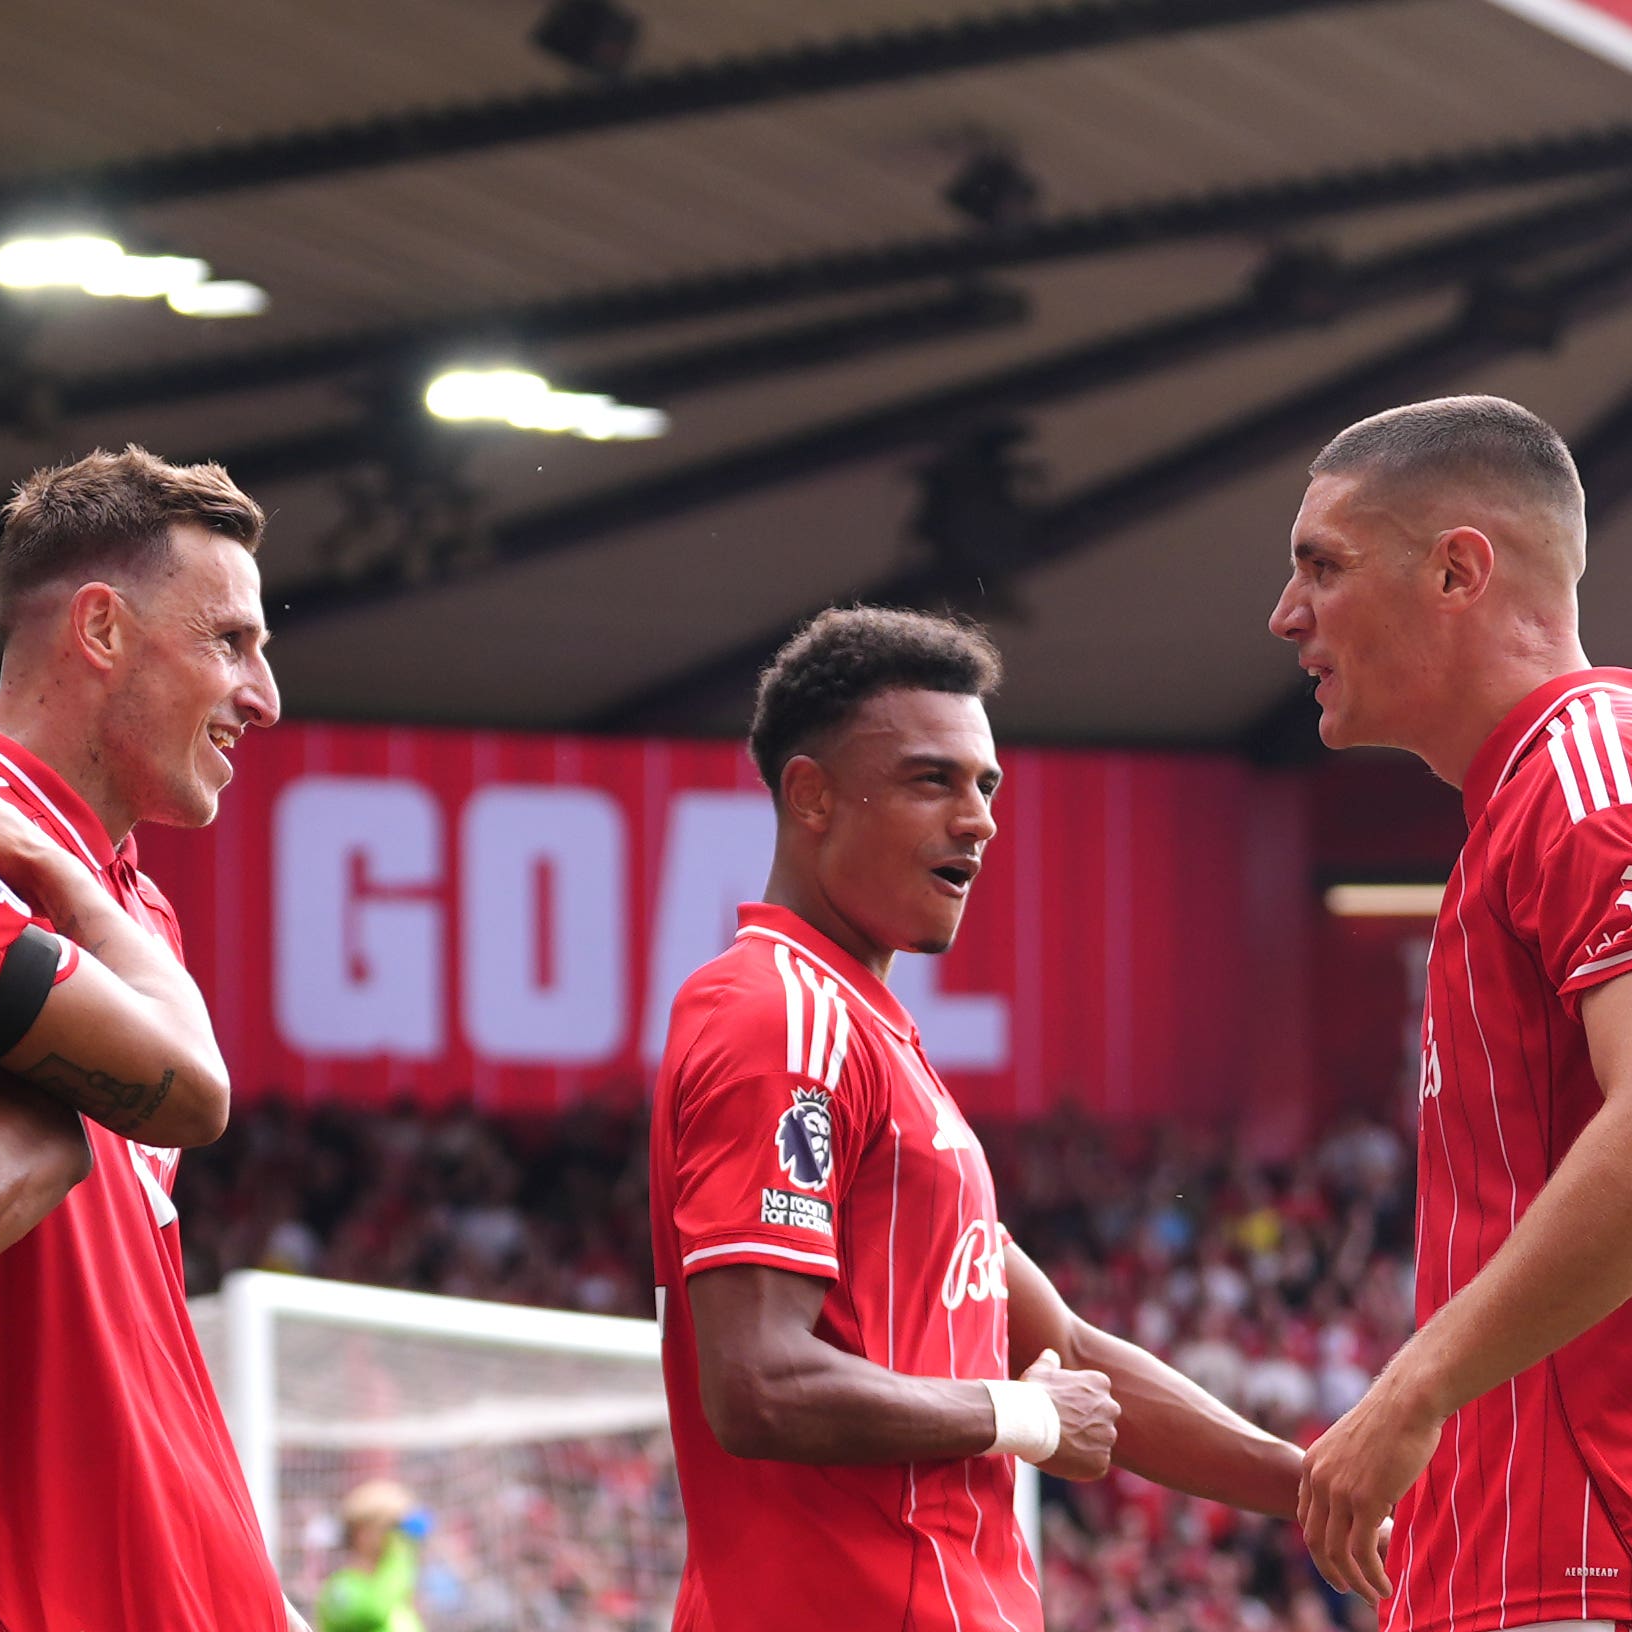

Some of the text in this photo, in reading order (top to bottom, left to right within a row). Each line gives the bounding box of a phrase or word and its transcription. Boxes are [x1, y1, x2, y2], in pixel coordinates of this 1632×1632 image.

[760, 1204, 788, 1224] for
[761, 1188, 828, 1221] No room
[1564, 1566, 1619, 1578] AEROREADY
